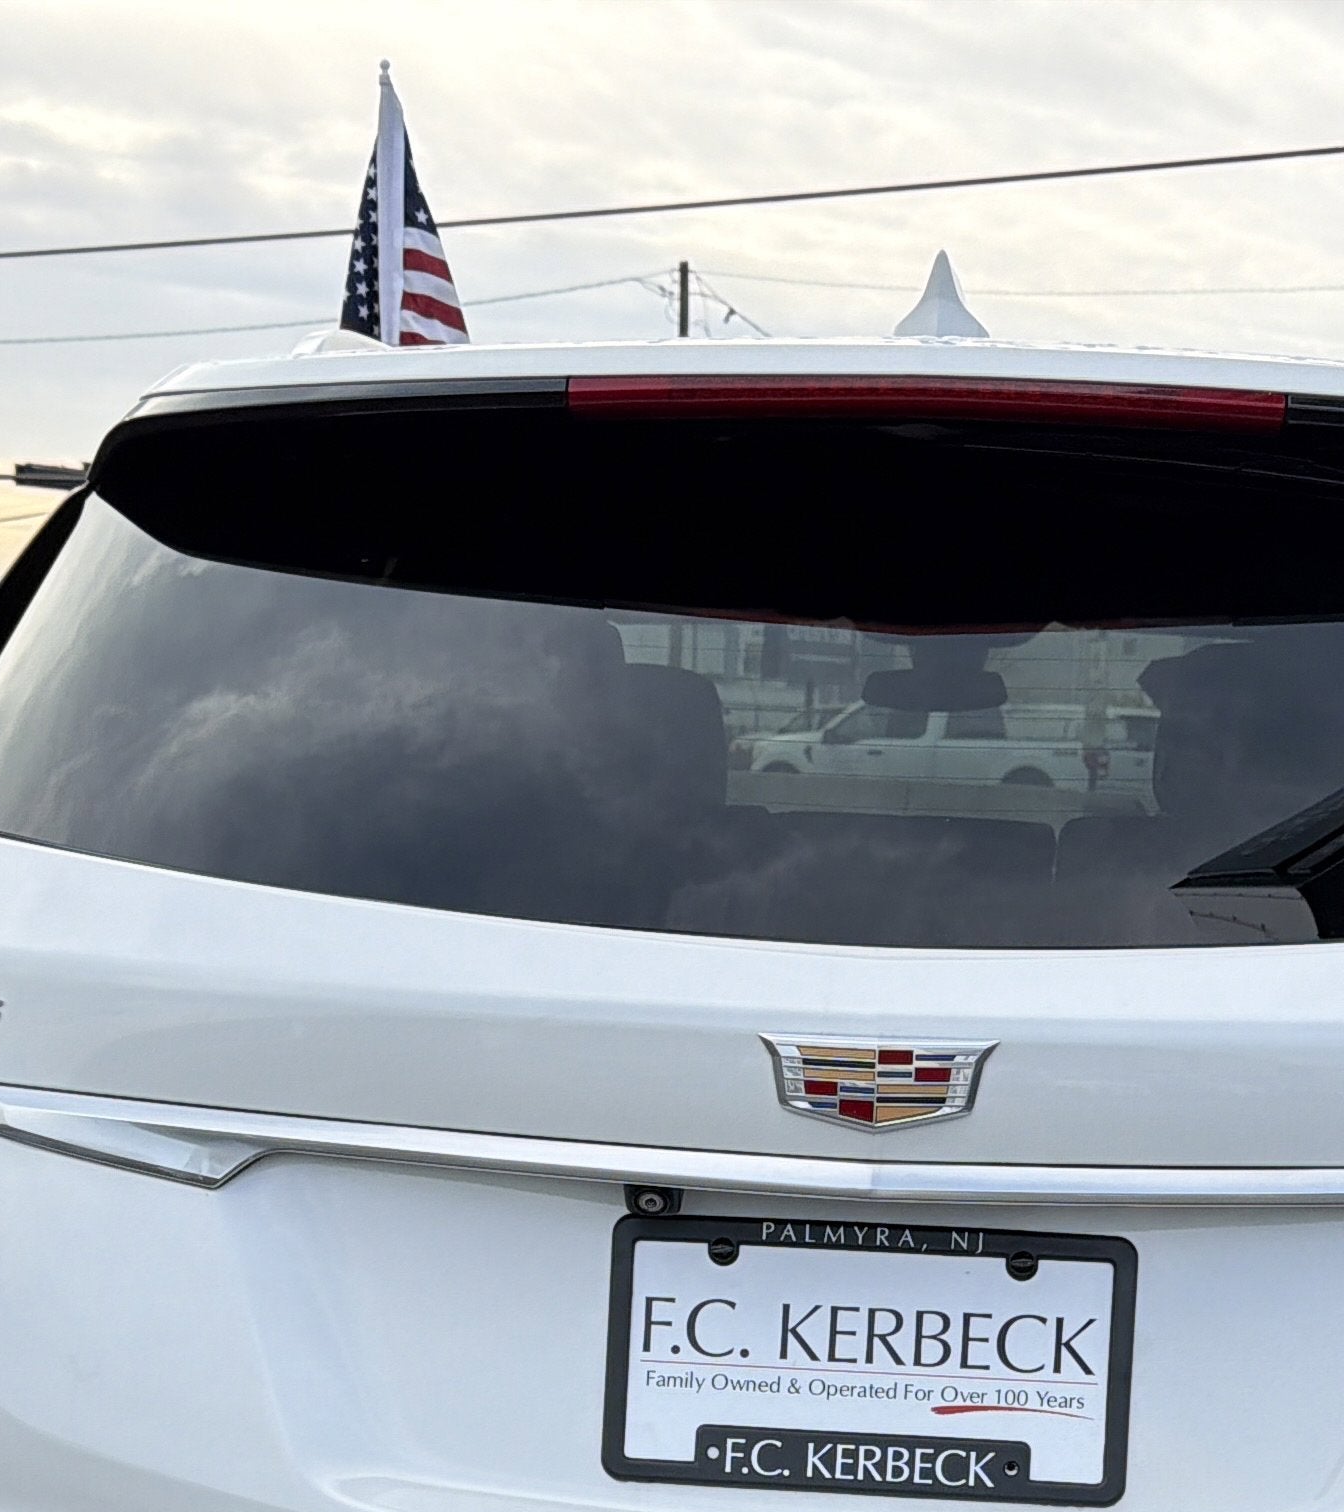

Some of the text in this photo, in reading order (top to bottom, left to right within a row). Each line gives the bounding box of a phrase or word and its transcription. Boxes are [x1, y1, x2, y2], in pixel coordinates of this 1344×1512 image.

[761, 1221, 986, 1254] PALMYRA, NJ
[641, 1295, 1099, 1377] F.C. KERBECK
[645, 1369, 1085, 1410] Family Owned & Operated For Over 100 Years
[724, 1437, 997, 1488] F.C. KERBECK
